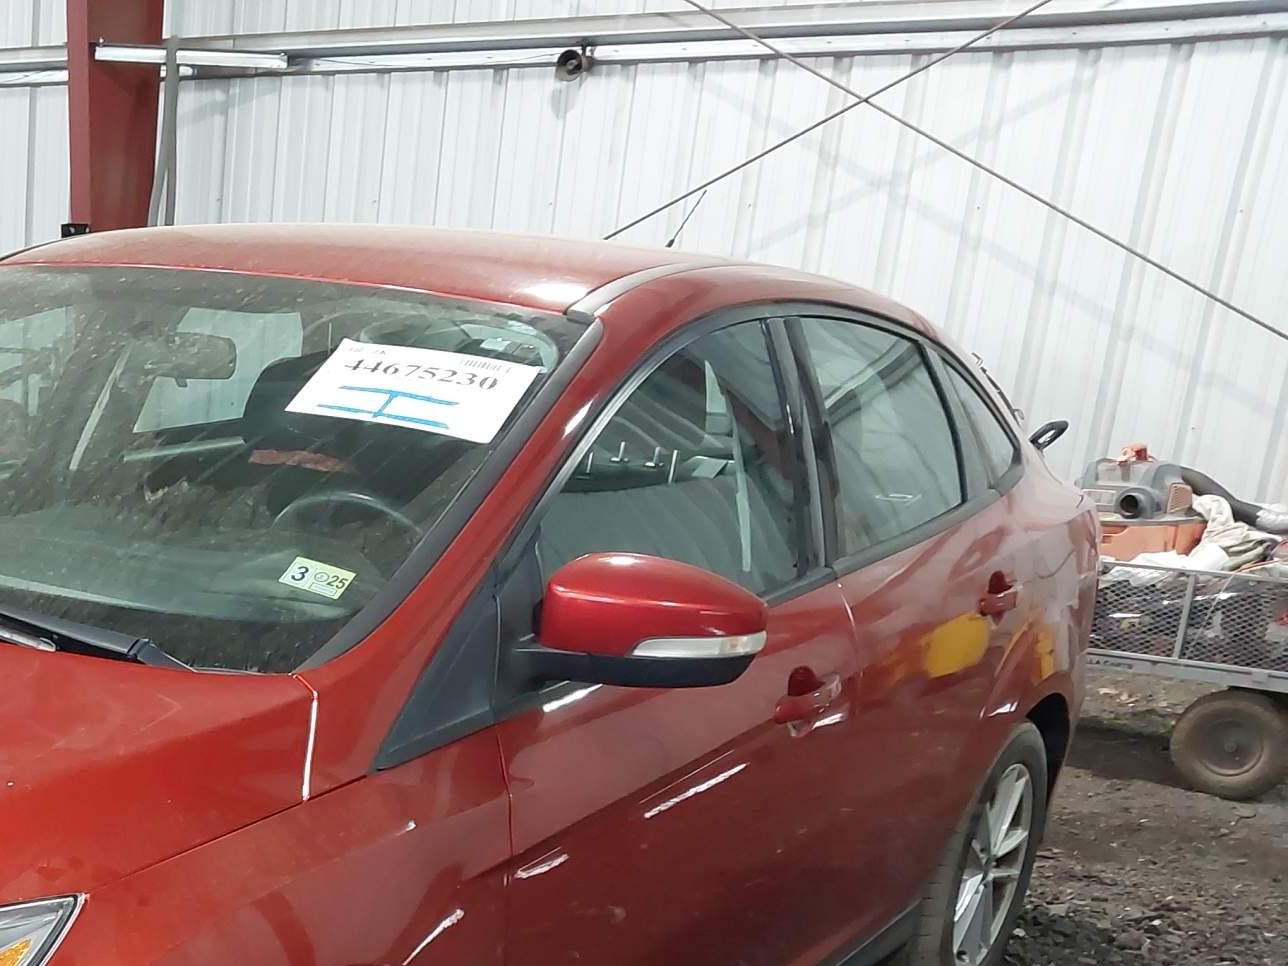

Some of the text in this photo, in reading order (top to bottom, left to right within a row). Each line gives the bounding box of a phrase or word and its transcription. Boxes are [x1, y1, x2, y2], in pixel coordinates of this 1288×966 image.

[344, 358, 499, 390] 44675230
[291, 565, 349, 590] 3 25
